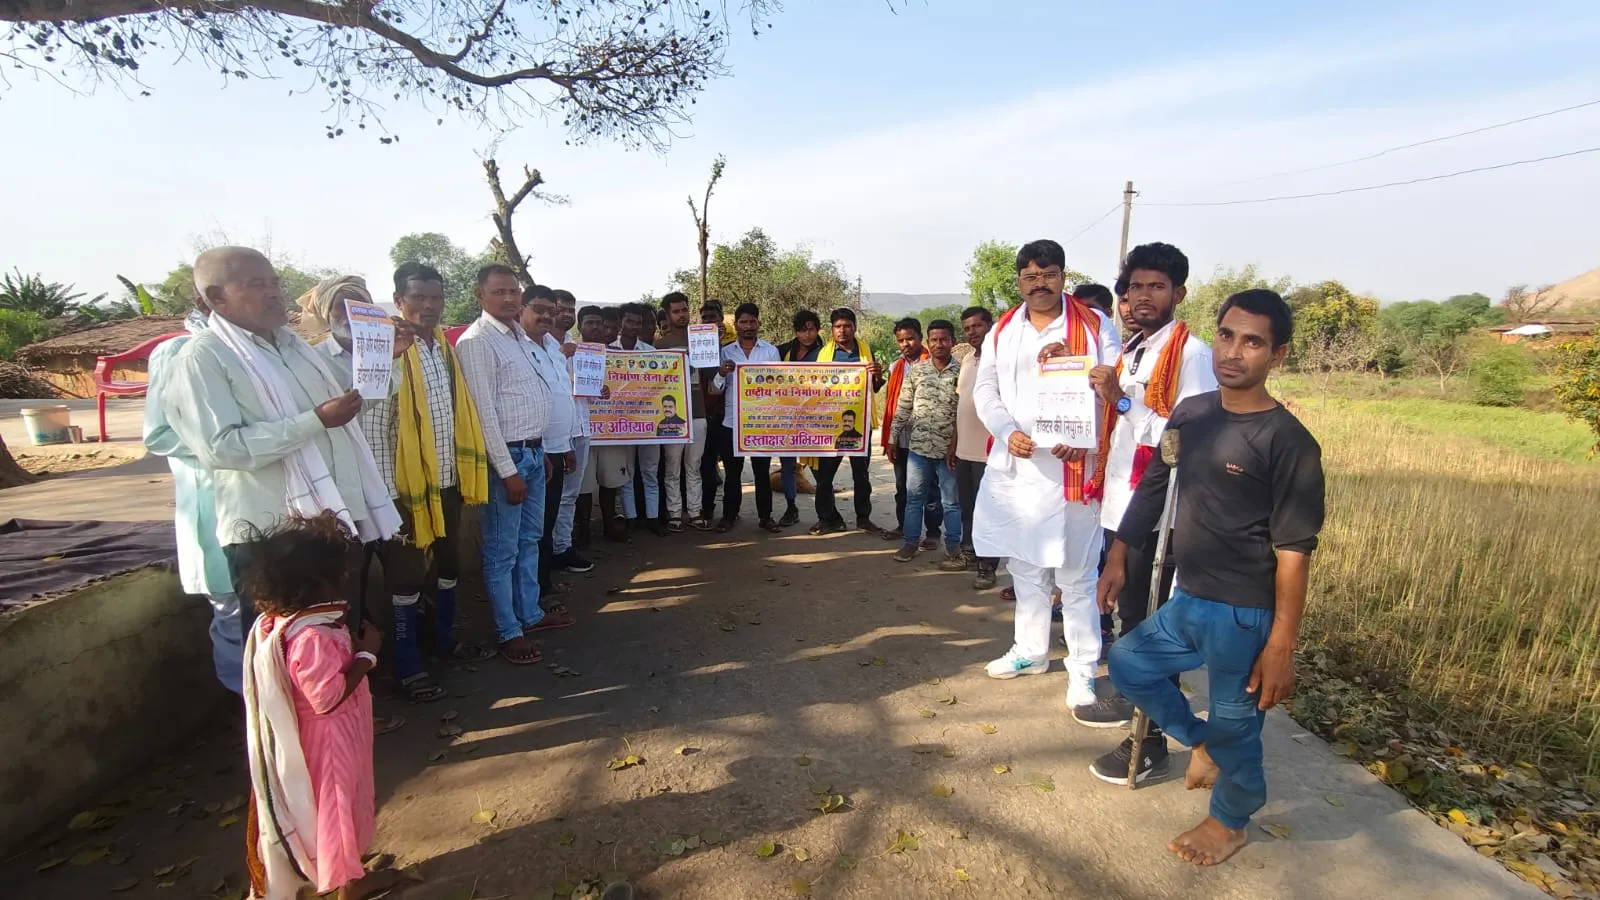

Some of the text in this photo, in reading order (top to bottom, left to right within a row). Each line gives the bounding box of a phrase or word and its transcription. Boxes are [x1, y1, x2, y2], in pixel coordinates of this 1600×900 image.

[608, 371, 640, 381] निर्माण
[642, 372, 661, 382] सेना
[775, 388, 787, 396] नव
[791, 387, 820, 397] निर्माण
[824, 387, 841, 397] सेना
[608, 418, 654, 433] अभियान
[1036, 416, 1052, 433] डॉक्टर
[1054, 415, 1062, 433] की
[1064, 416, 1083, 439] नियुक्ति
[744, 435, 786, 447] हस्ताक्षर
[789, 432, 833, 446] अभियान
